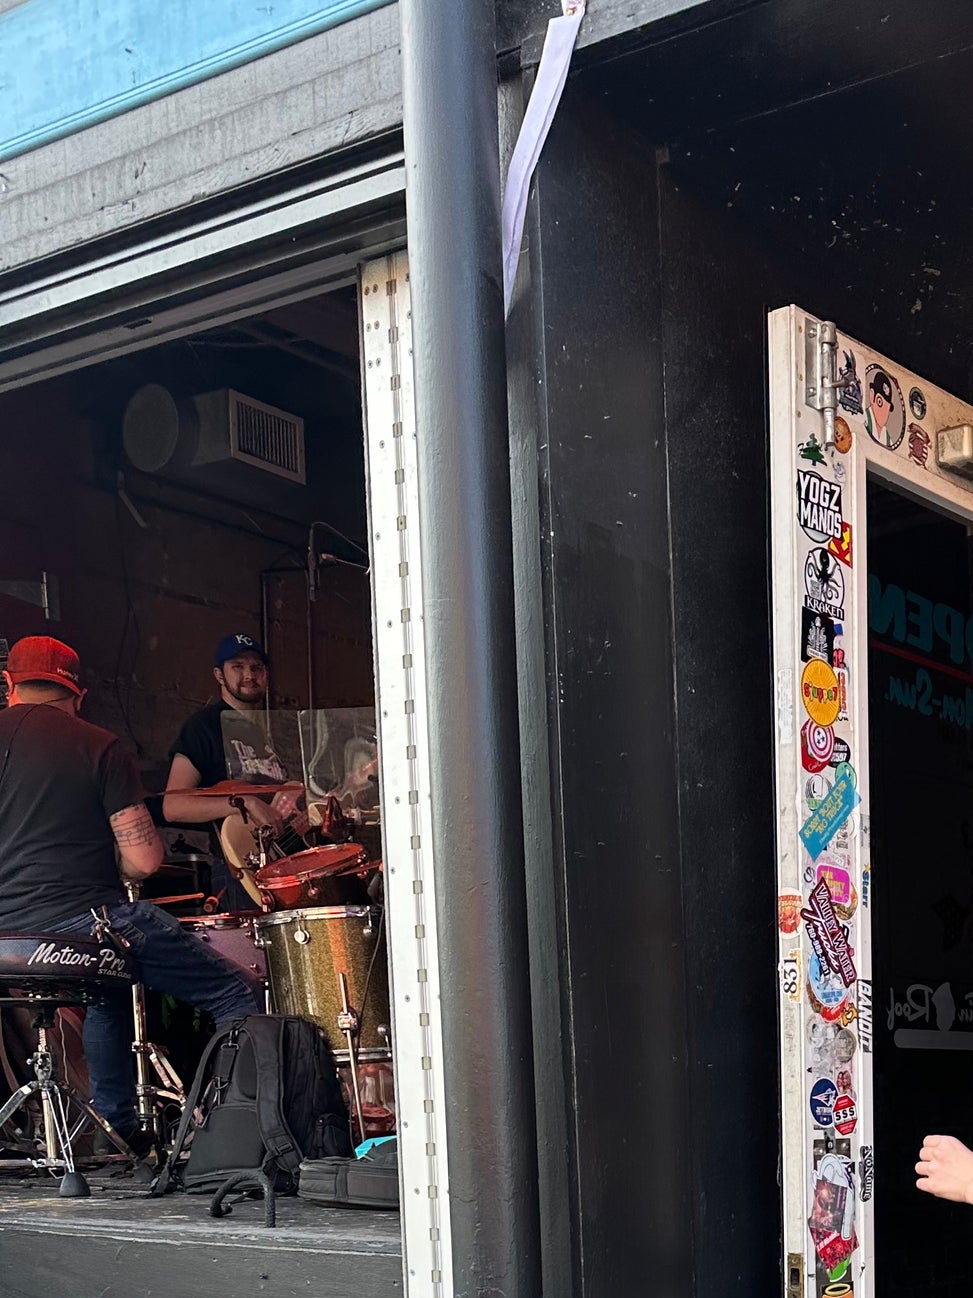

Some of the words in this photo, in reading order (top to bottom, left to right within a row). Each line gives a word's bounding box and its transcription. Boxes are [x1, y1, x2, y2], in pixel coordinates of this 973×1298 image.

[798, 471, 841, 512] YOGZ
[800, 499, 843, 539] MANOS
[806, 597, 844, 619] KRAKEN
[815, 884, 838, 933] VALLEY
[831, 932, 857, 983] WATER
[27, 943, 126, 970] Motion-Pro
[783, 958, 798, 995] 831
